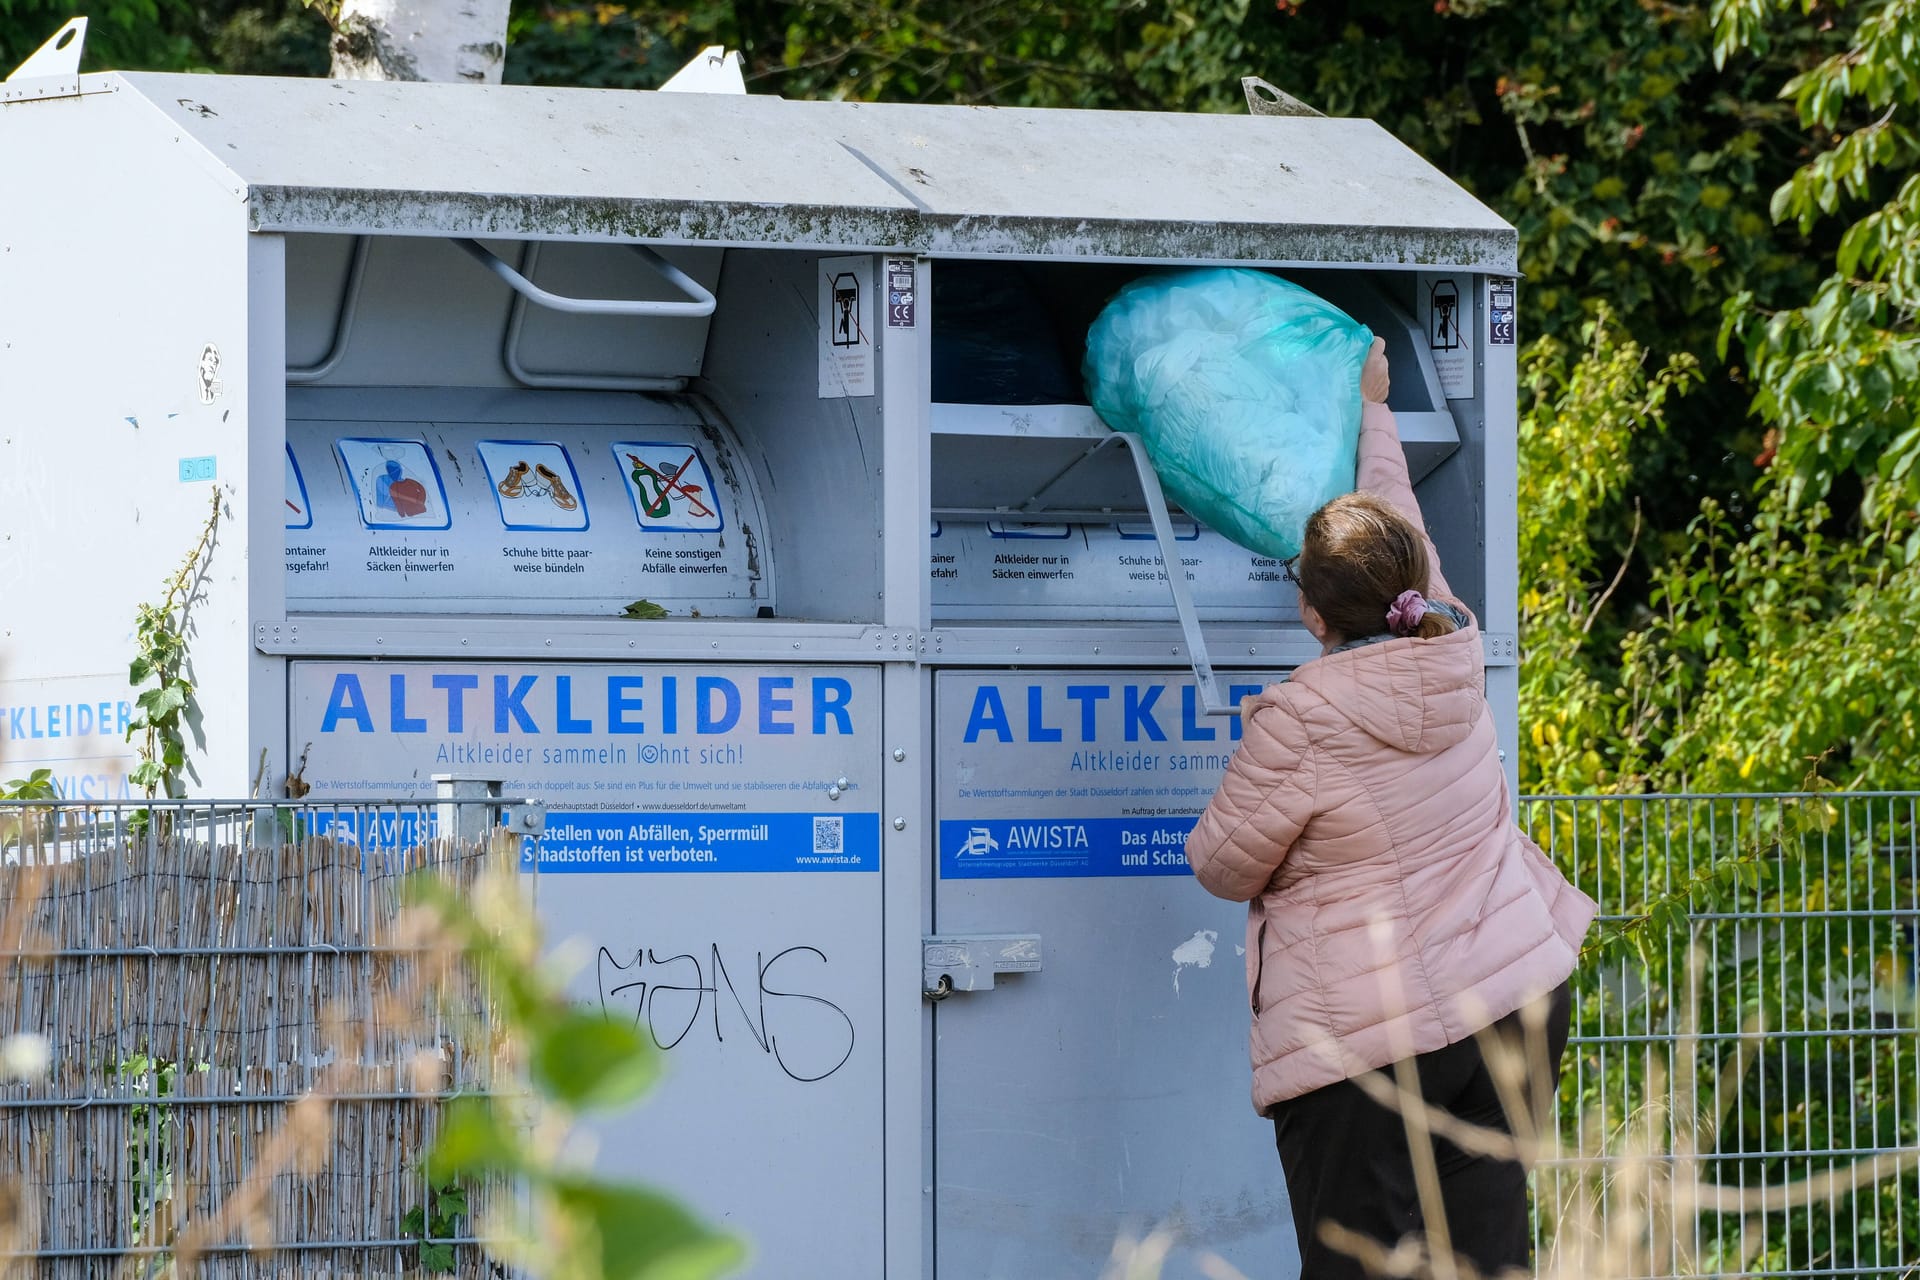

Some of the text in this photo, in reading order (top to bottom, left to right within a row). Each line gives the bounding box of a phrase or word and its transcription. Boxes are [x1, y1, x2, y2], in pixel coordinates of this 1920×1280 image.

[894, 306, 909, 319] CE
[1495, 324, 1509, 337] CE
[285, 546, 326, 557] ontainer
[369, 546, 450, 557] Altkleider nur in
[502, 547, 593, 560] Schuhe bitte paar-
[645, 548, 722, 561] Keine sonstigen
[994, 554, 1069, 565] Altkleider nur in
[1118, 556, 1152, 566] Schuhe
[1251, 557, 1276, 567] Keine
[366, 561, 455, 572] Säcken einwerfen
[513, 563, 584, 573] weise bündeln
[641, 563, 728, 574] Abfälle einwerfen
[992, 568, 1074, 580] Säcken einwerfen
[1128, 571, 1155, 580] weise
[1248, 571, 1280, 582] Abfälle
[321, 674, 853, 735] ALTKLEIDER
[436, 742, 533, 764] Altkleider
[543, 743, 626, 764] sammeln
[700, 743, 744, 764] sich!
[1071, 750, 1235, 771] Altkleider samme
[315, 780, 433, 791] Die Wertstoffsammlungen der
[527, 781, 543, 790] sich
[545, 780, 574, 792] doppelt
[594, 781, 605, 790] Sie
[607, 781, 623, 790] sind
[625, 781, 636, 790] ein
[639, 781, 654, 790] Plus
[656, 781, 667, 790] für
[669, 781, 681, 790] die
[682, 781, 713, 790] Umwelt
[714, 781, 729, 790] und
[732, 781, 742, 790] sie
[744, 781, 787, 790] stabilisieren
[789, 781, 800, 790] die
[959, 789, 971, 798] Die
[973, 788, 1054, 799] Wertstoffsammlungen
[1055, 788, 1067, 797] der
[1069, 788, 1089, 797] Stadt
[1090, 787, 1129, 796] Düsseldorf
[1130, 787, 1154, 796] zahlen
[1155, 787, 1169, 796] sich
[1171, 787, 1199, 798] doppelt
[545, 802, 746, 811] andeshauptstadt Düsseldorf www.duesseldorf.de/umweltamt
[1122, 807, 1131, 815] Im
[1132, 807, 1155, 816] Auftrag
[1156, 807, 1167, 815] der
[597, 829, 624, 841] von
[628, 825, 694, 844] Abfällen,
[698, 825, 769, 844] Sperrmüll
[1006, 825, 1089, 849] AWISTA
[1122, 830, 1147, 845] Das
[626, 846, 644, 862] ist
[648, 846, 718, 862] verboten.
[796, 855, 861, 864] www.awista.de
[1122, 850, 1148, 866] und
